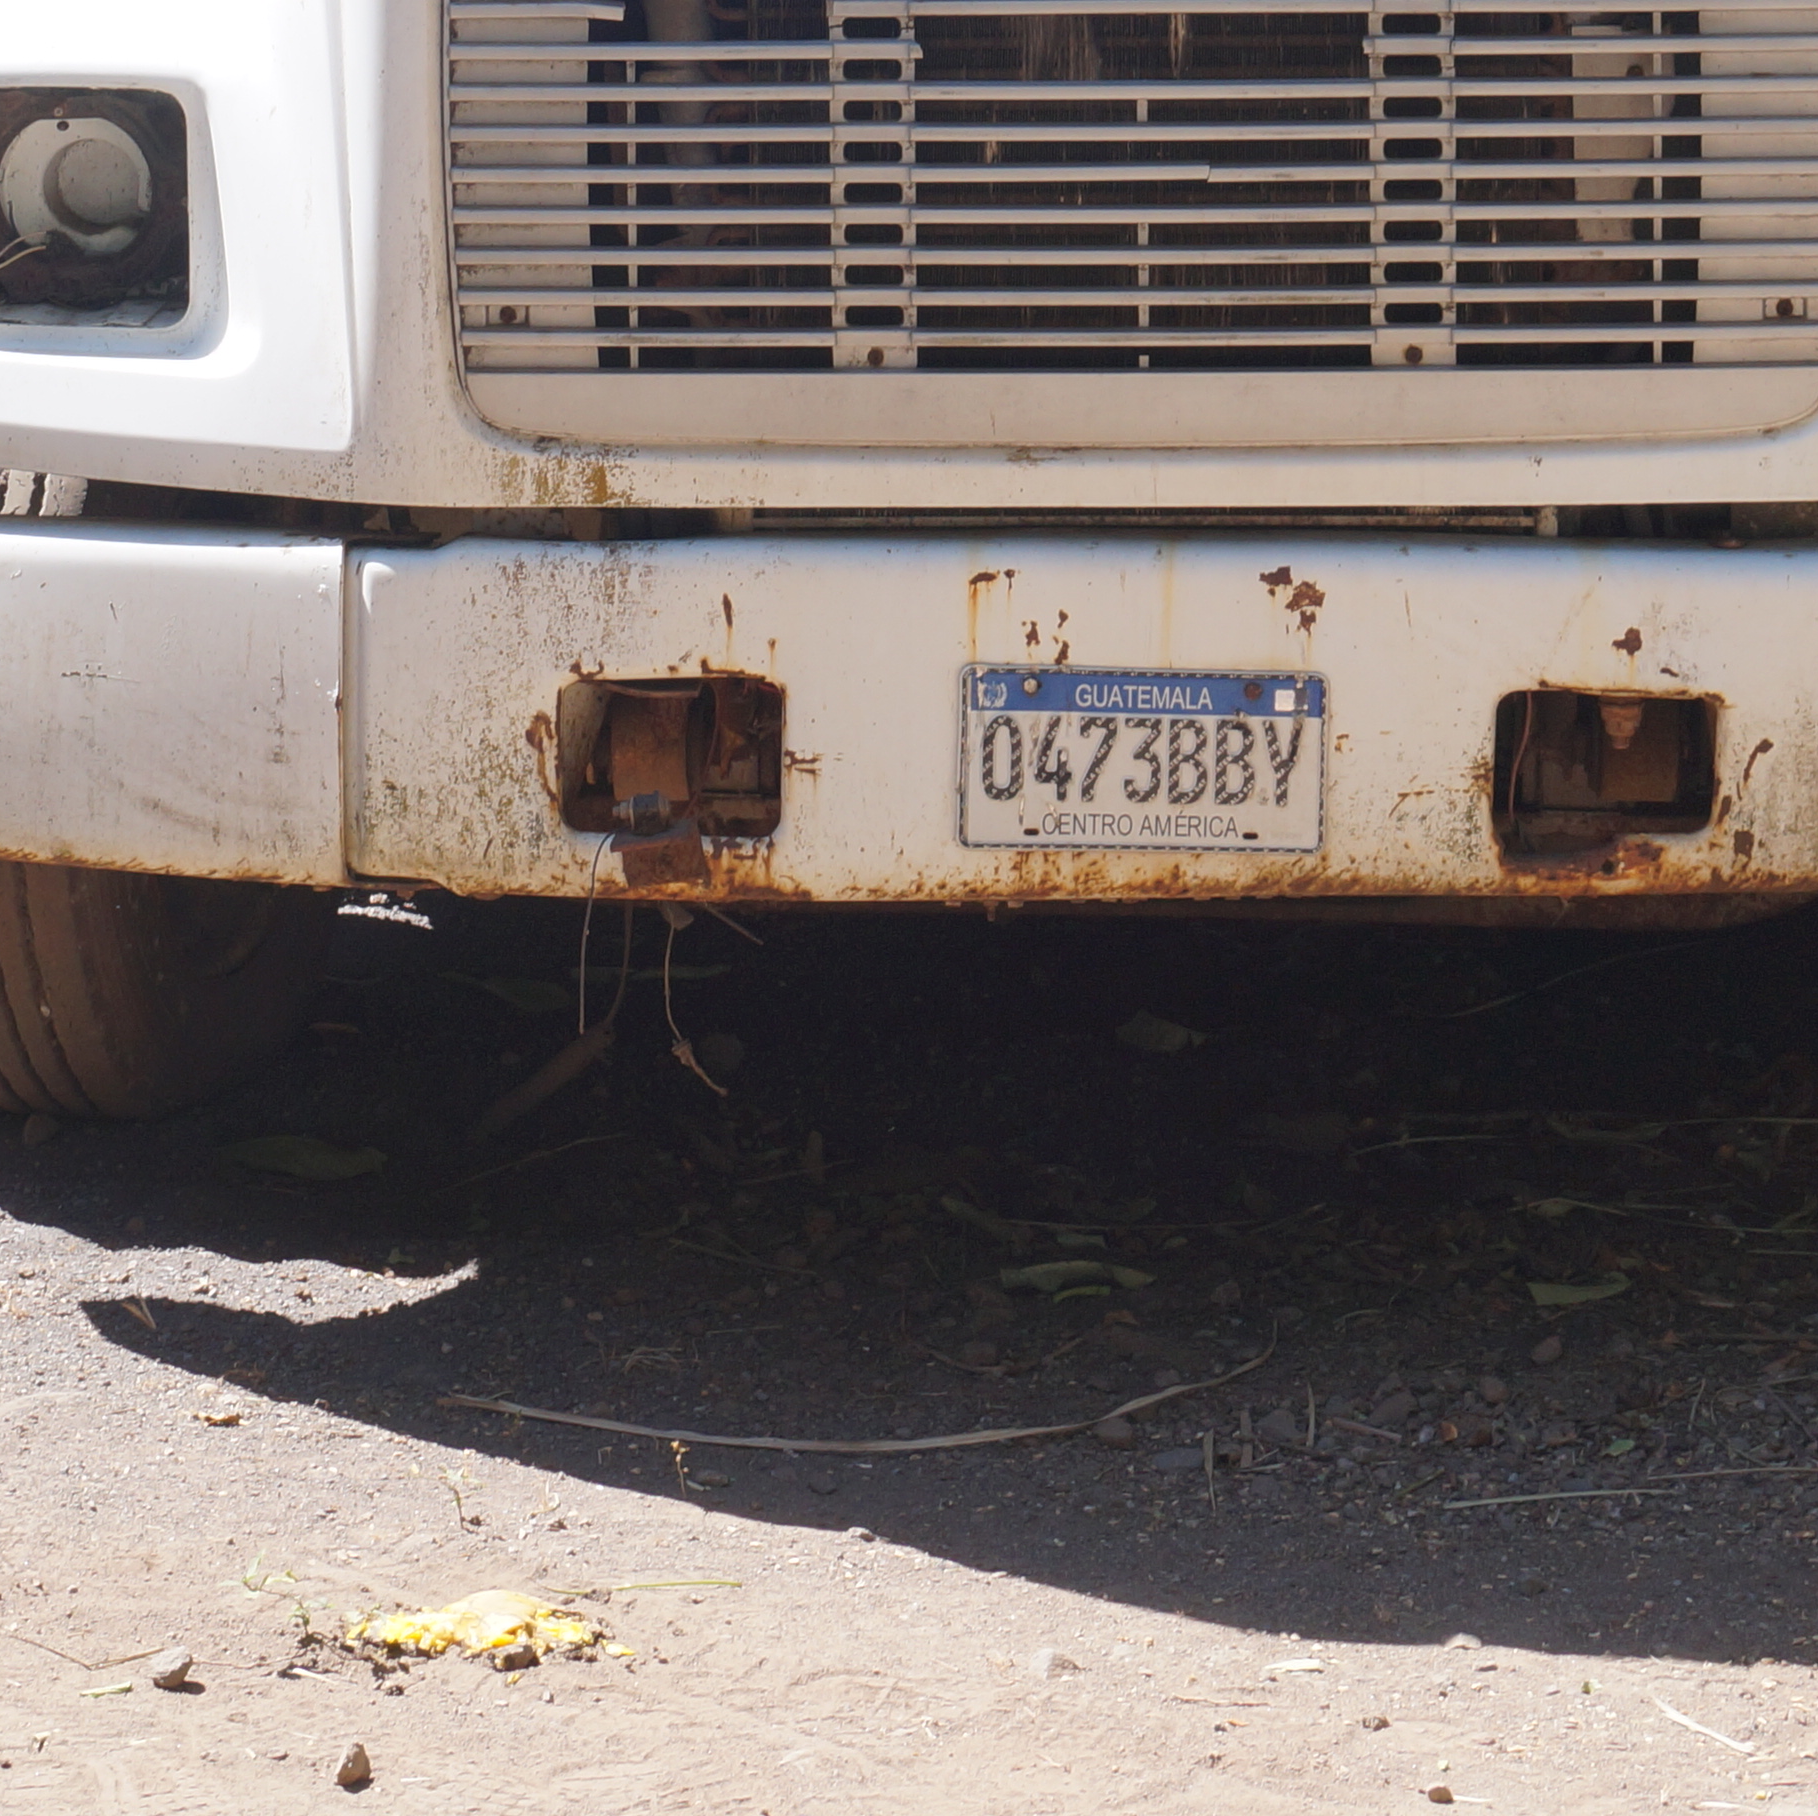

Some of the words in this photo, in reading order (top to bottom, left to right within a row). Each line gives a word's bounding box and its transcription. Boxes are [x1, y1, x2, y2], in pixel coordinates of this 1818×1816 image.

[1074, 683, 1213, 711] GUATEMALA
[982, 715, 1303, 807] 0473BBY
[1041, 813, 1134, 837] CENTRO
